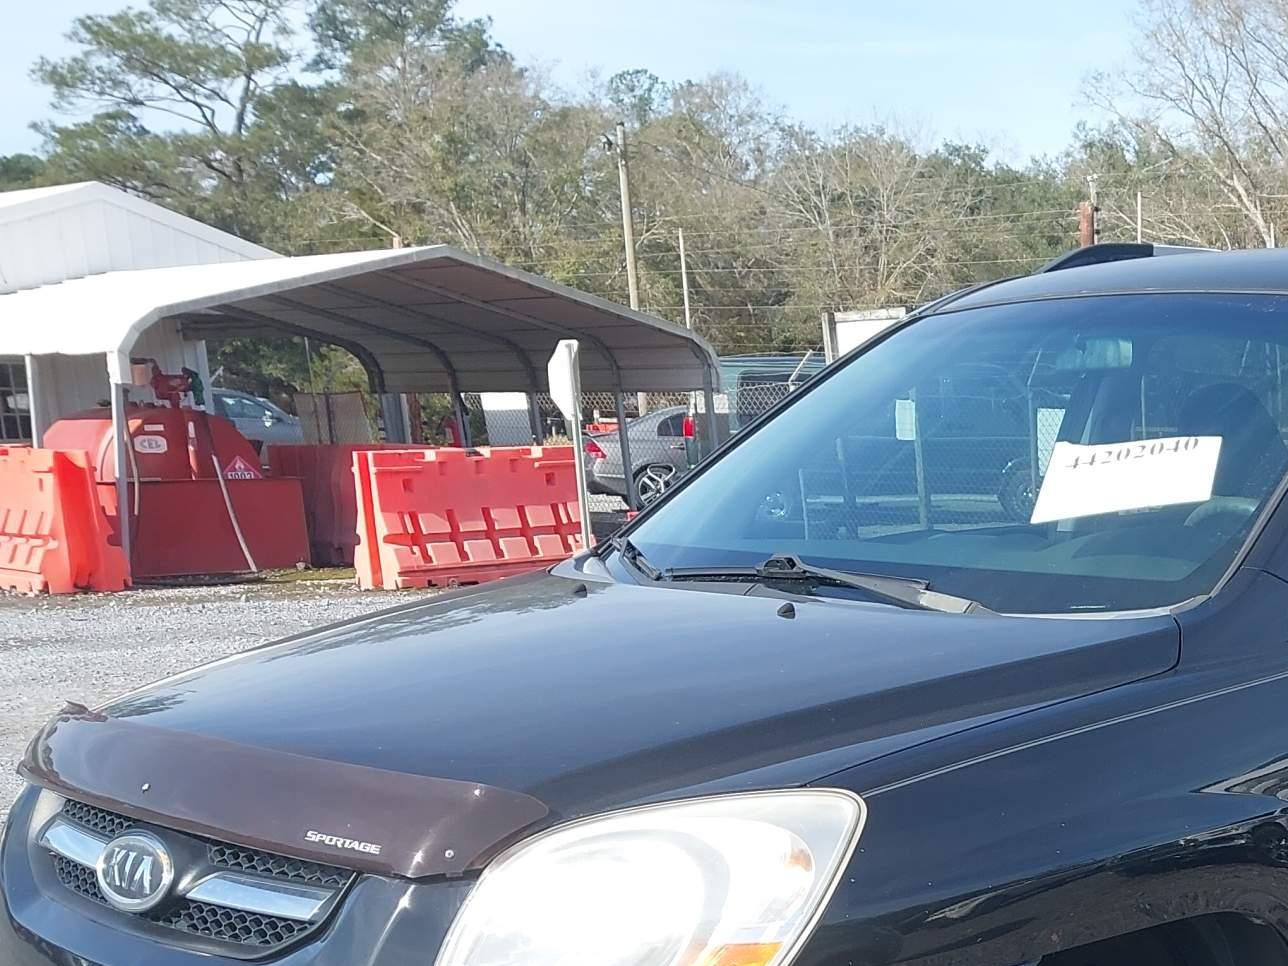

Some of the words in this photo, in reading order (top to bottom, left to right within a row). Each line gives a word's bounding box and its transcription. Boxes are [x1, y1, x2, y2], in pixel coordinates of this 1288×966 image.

[1064, 437, 1199, 469] 44202040
[304, 830, 382, 855] SPORTAGE
[106, 847, 153, 895] KIA
